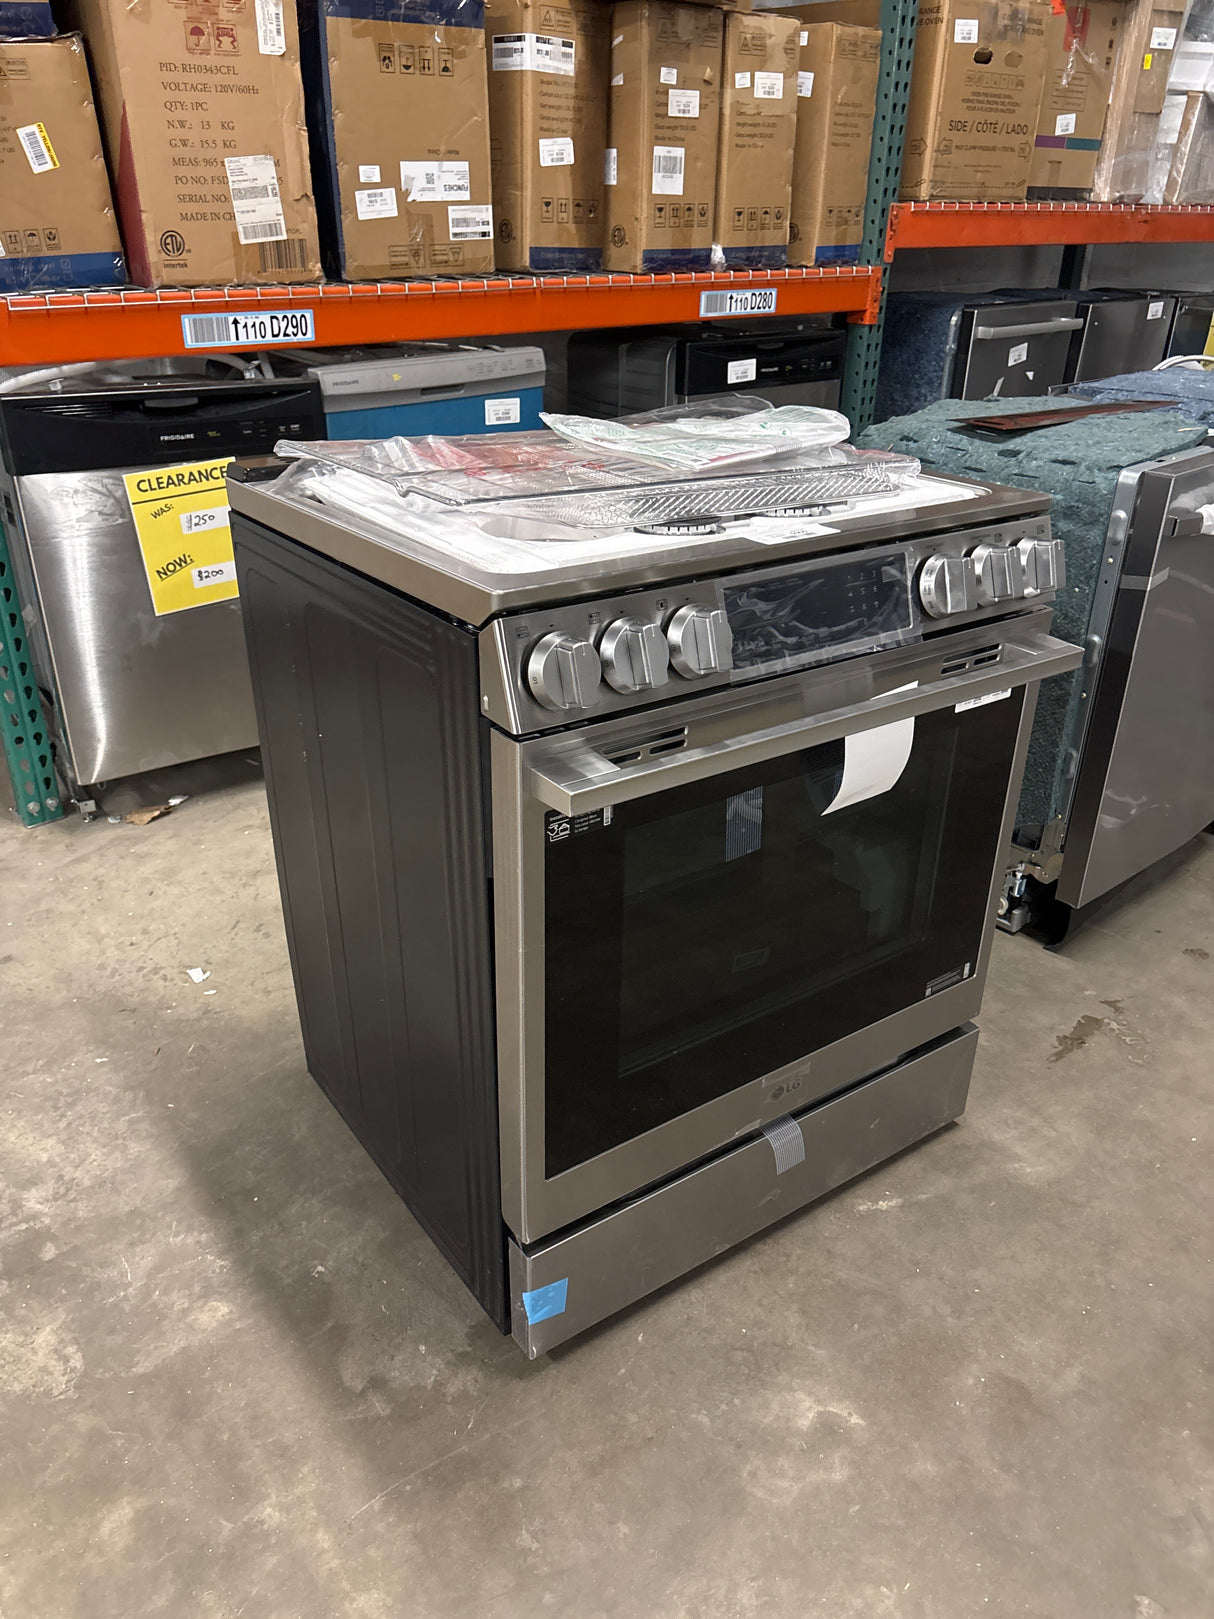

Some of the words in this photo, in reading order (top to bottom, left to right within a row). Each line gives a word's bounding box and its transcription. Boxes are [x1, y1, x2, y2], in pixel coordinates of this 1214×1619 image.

[925, 17, 944, 25] OVEN
[159, 62, 180, 73] PID:
[181, 63, 239, 76] RH0343CFL
[161, 82, 212, 93] VOLTAGE:
[214, 84, 260, 94] 120V/60Hz
[164, 101, 189, 112] QTY:
[190, 102, 208, 111] 1PC
[166, 120, 193, 130] N.W.:
[200, 121, 211, 130] 13
[220, 121, 235, 131] KG
[948, 119, 968, 133] SIDE
[970, 121, 975, 133] /
[976, 119, 998, 134] CÔTÉ
[999, 122, 1005, 135] /
[1006, 123, 1029, 135] LADO
[169, 139, 195, 149] G.W.:
[200, 140, 217, 149] 15.5
[222, 140, 237, 149] KG
[172, 157, 201, 167] MEAS:
[202, 158, 218, 168] 965
[174, 176, 188, 185] PO
[190, 175, 209, 185] NO:
[443, 183, 469, 192] FUNCHES
[176, 194, 209, 204] SERIAL
[211, 194, 229, 204] NO:
[180, 212, 209, 222] MADE
[210, 212, 221, 222] IN
[733, 296, 748, 311] 110
[750, 291, 773, 310] D280
[242, 321, 267, 340] 110
[270, 313, 308, 338] D290
[160, 433, 195, 441] FRIGIDAIRE
[136, 465, 227, 493] CLEARANCE
[150, 503, 174, 520] WAS:
[155, 554, 195, 580] NOW:
[786, 1078, 801, 1093] LG
